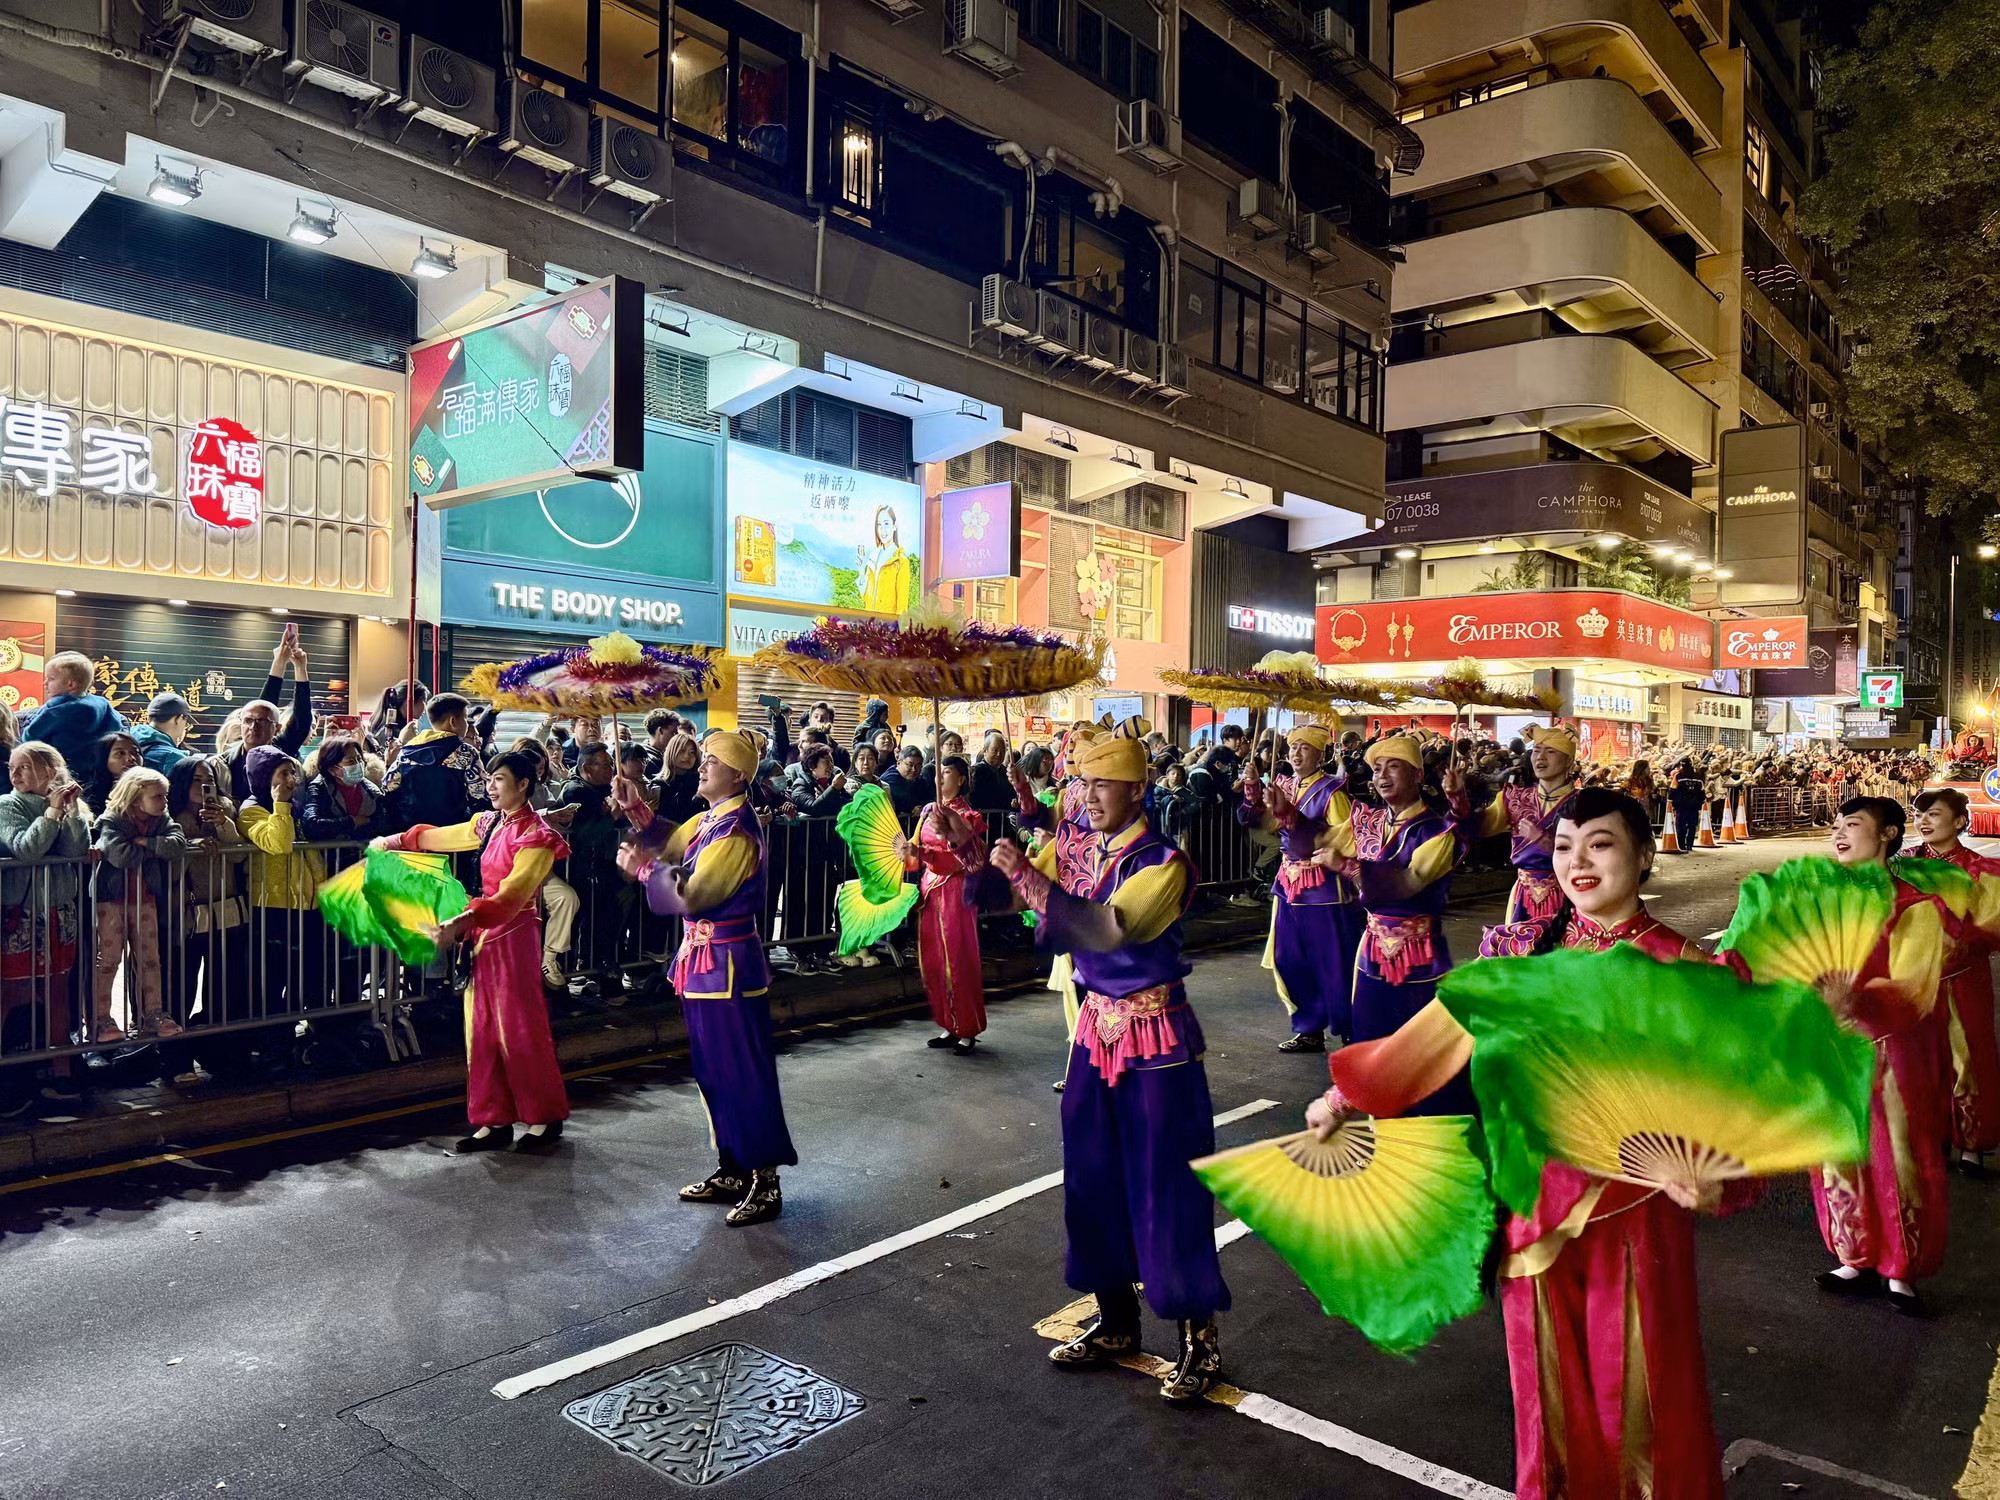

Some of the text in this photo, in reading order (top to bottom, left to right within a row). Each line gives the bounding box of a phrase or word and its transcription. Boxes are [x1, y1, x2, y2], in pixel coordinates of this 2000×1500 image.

[803, 471, 856, 492] 精神活力
[1578, 482, 1595, 492] the
[1404, 492, 1431, 502] LEASE
[1537, 495, 1622, 510] CAMPHORA
[1725, 491, 1797, 506] CAMPHORA
[1386, 503, 1440, 521] 07 0038
[493, 582, 544, 611] THE
[551, 588, 617, 618] BODY
[733, 625, 766, 642] VITA
[1254, 608, 1315, 641] TISSOT
[1448, 614, 1563, 645] EMPEROR
[1616, 618, 1653, 647] 英皇珠寶
[1727, 631, 1797, 658] EMPEROR
